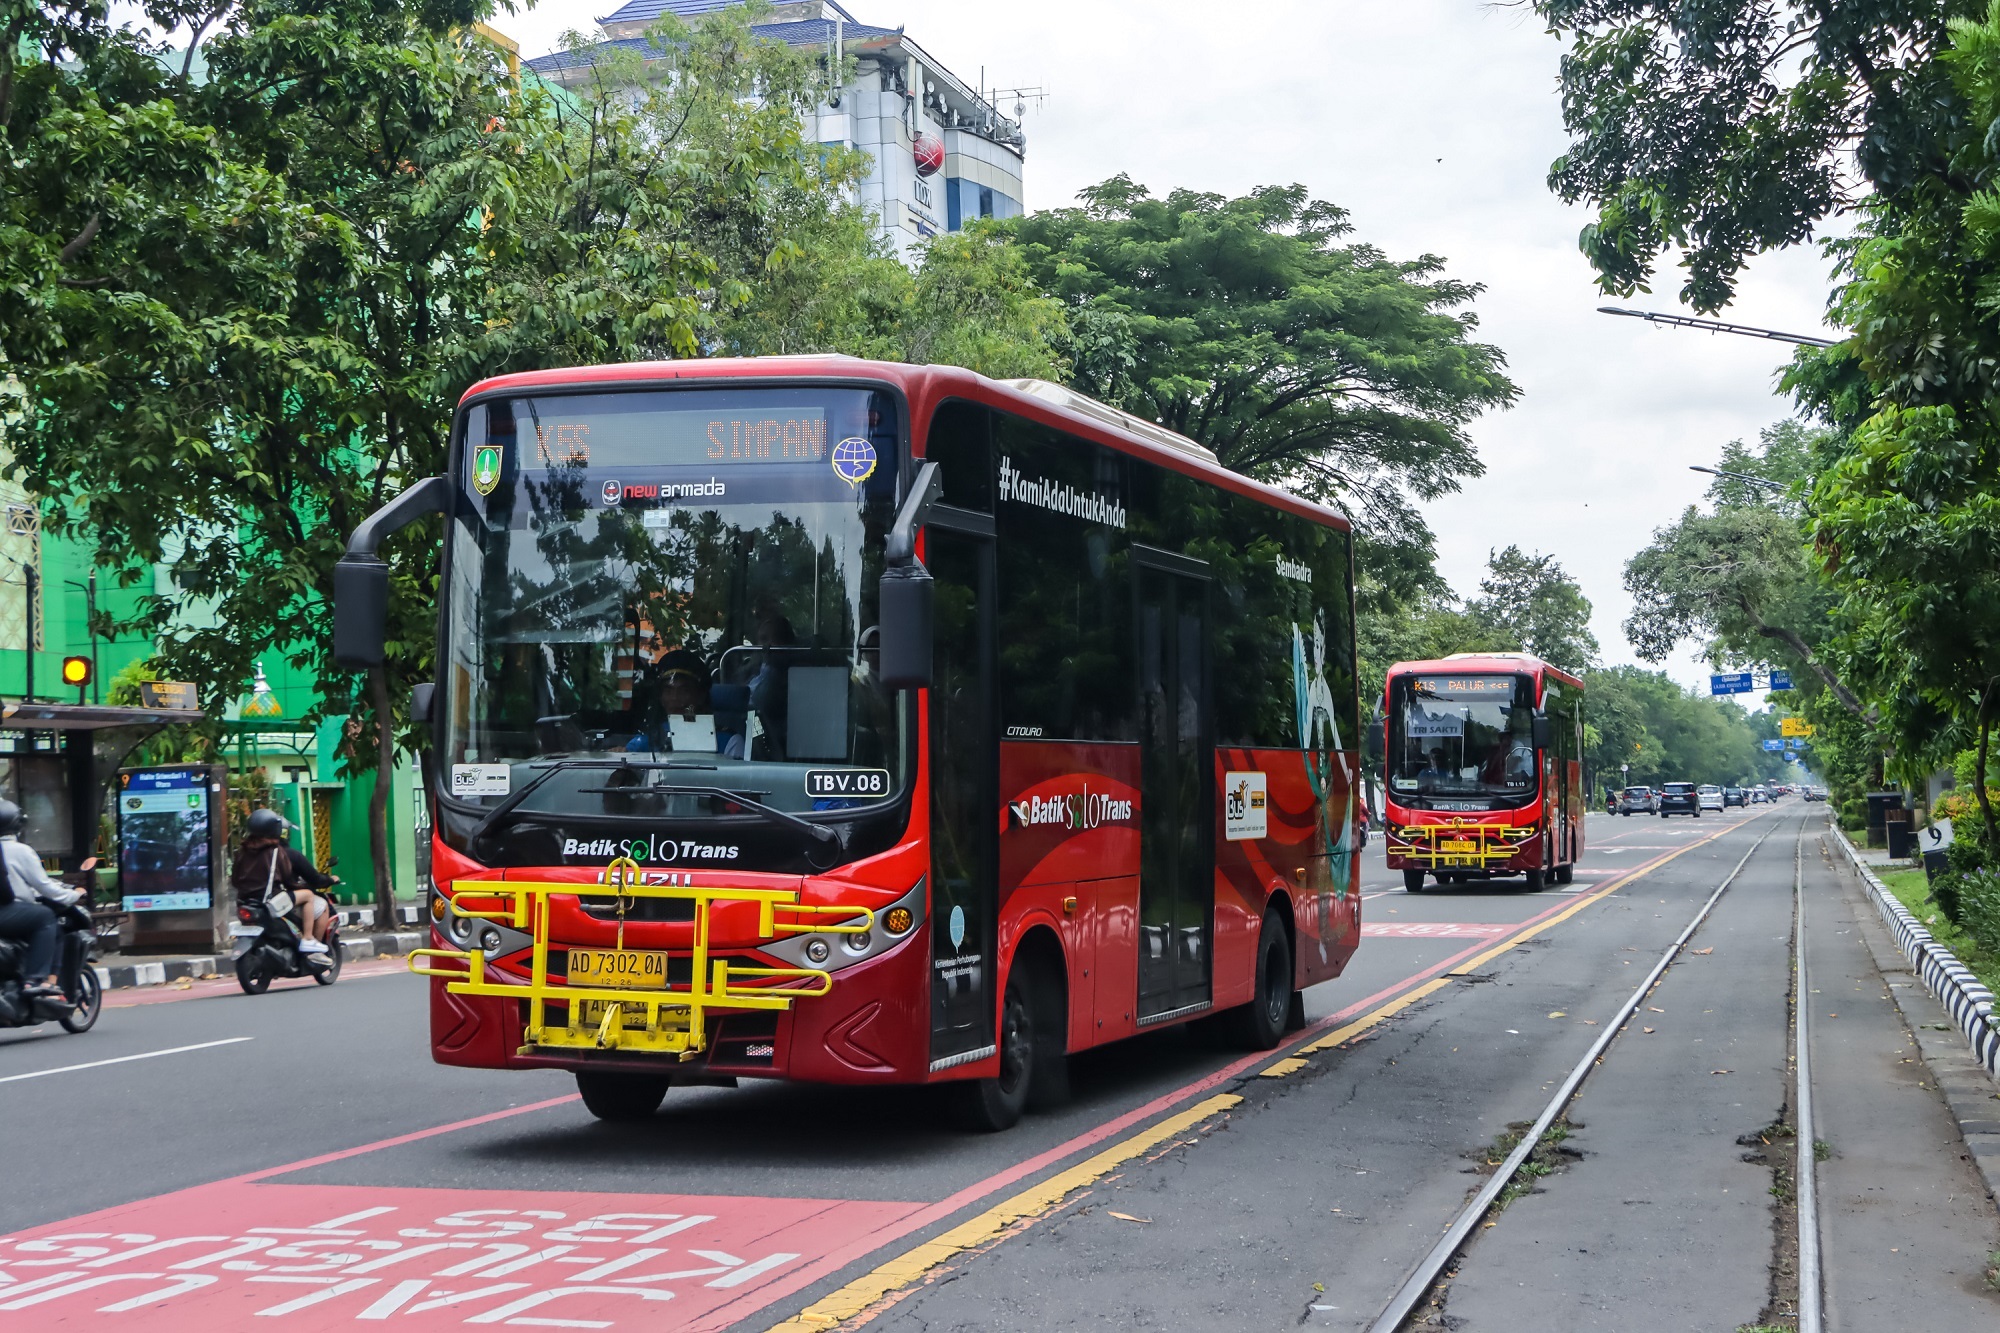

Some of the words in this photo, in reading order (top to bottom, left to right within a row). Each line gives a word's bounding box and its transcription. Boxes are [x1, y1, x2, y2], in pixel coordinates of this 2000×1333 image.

[707, 419, 827, 458] SIMPAN
[623, 485, 658, 498] new
[660, 477, 725, 497] armada
[999, 456, 1126, 529] #KamiAdaUntukAnda
[1276, 554, 1312, 583] Sembadra
[1448, 681, 1485, 691] PALUR
[813, 774, 881, 791] TBV.08
[1031, 795, 1065, 824] Batik
[1101, 794, 1131, 820] Trans
[563, 838, 617, 855] Batik
[680, 841, 739, 859] Trans
[1928, 827, 1942, 846] 9
[571, 953, 590, 973] AD
[597, 953, 638, 975] 7302
[245, 1206, 717, 1243] BST
[0, 1232, 801, 1288] KHUSUS
